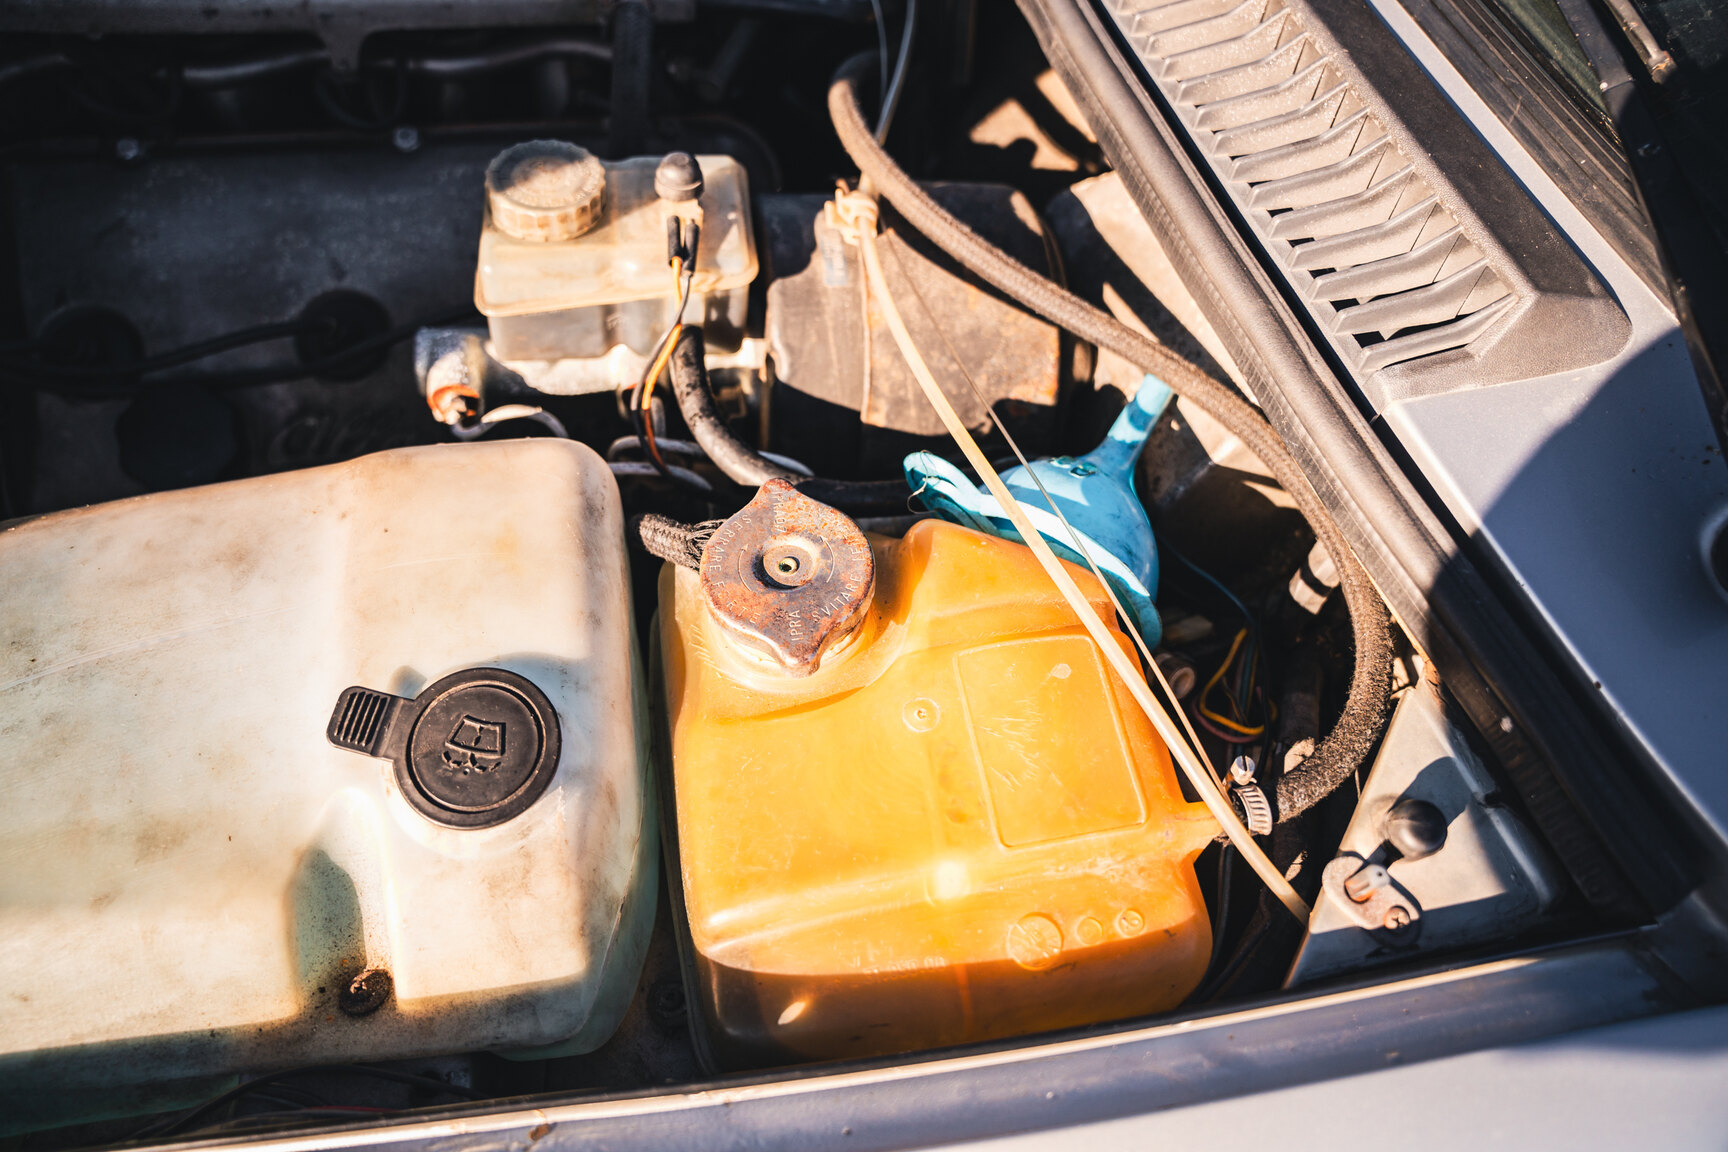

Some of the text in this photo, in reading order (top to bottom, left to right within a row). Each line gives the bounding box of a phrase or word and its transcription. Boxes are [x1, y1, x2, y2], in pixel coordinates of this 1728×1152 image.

[709, 514, 752, 572] SERRARE
[811, 573, 862, 623] SVITARE
[788, 609, 804, 641] IPRA
